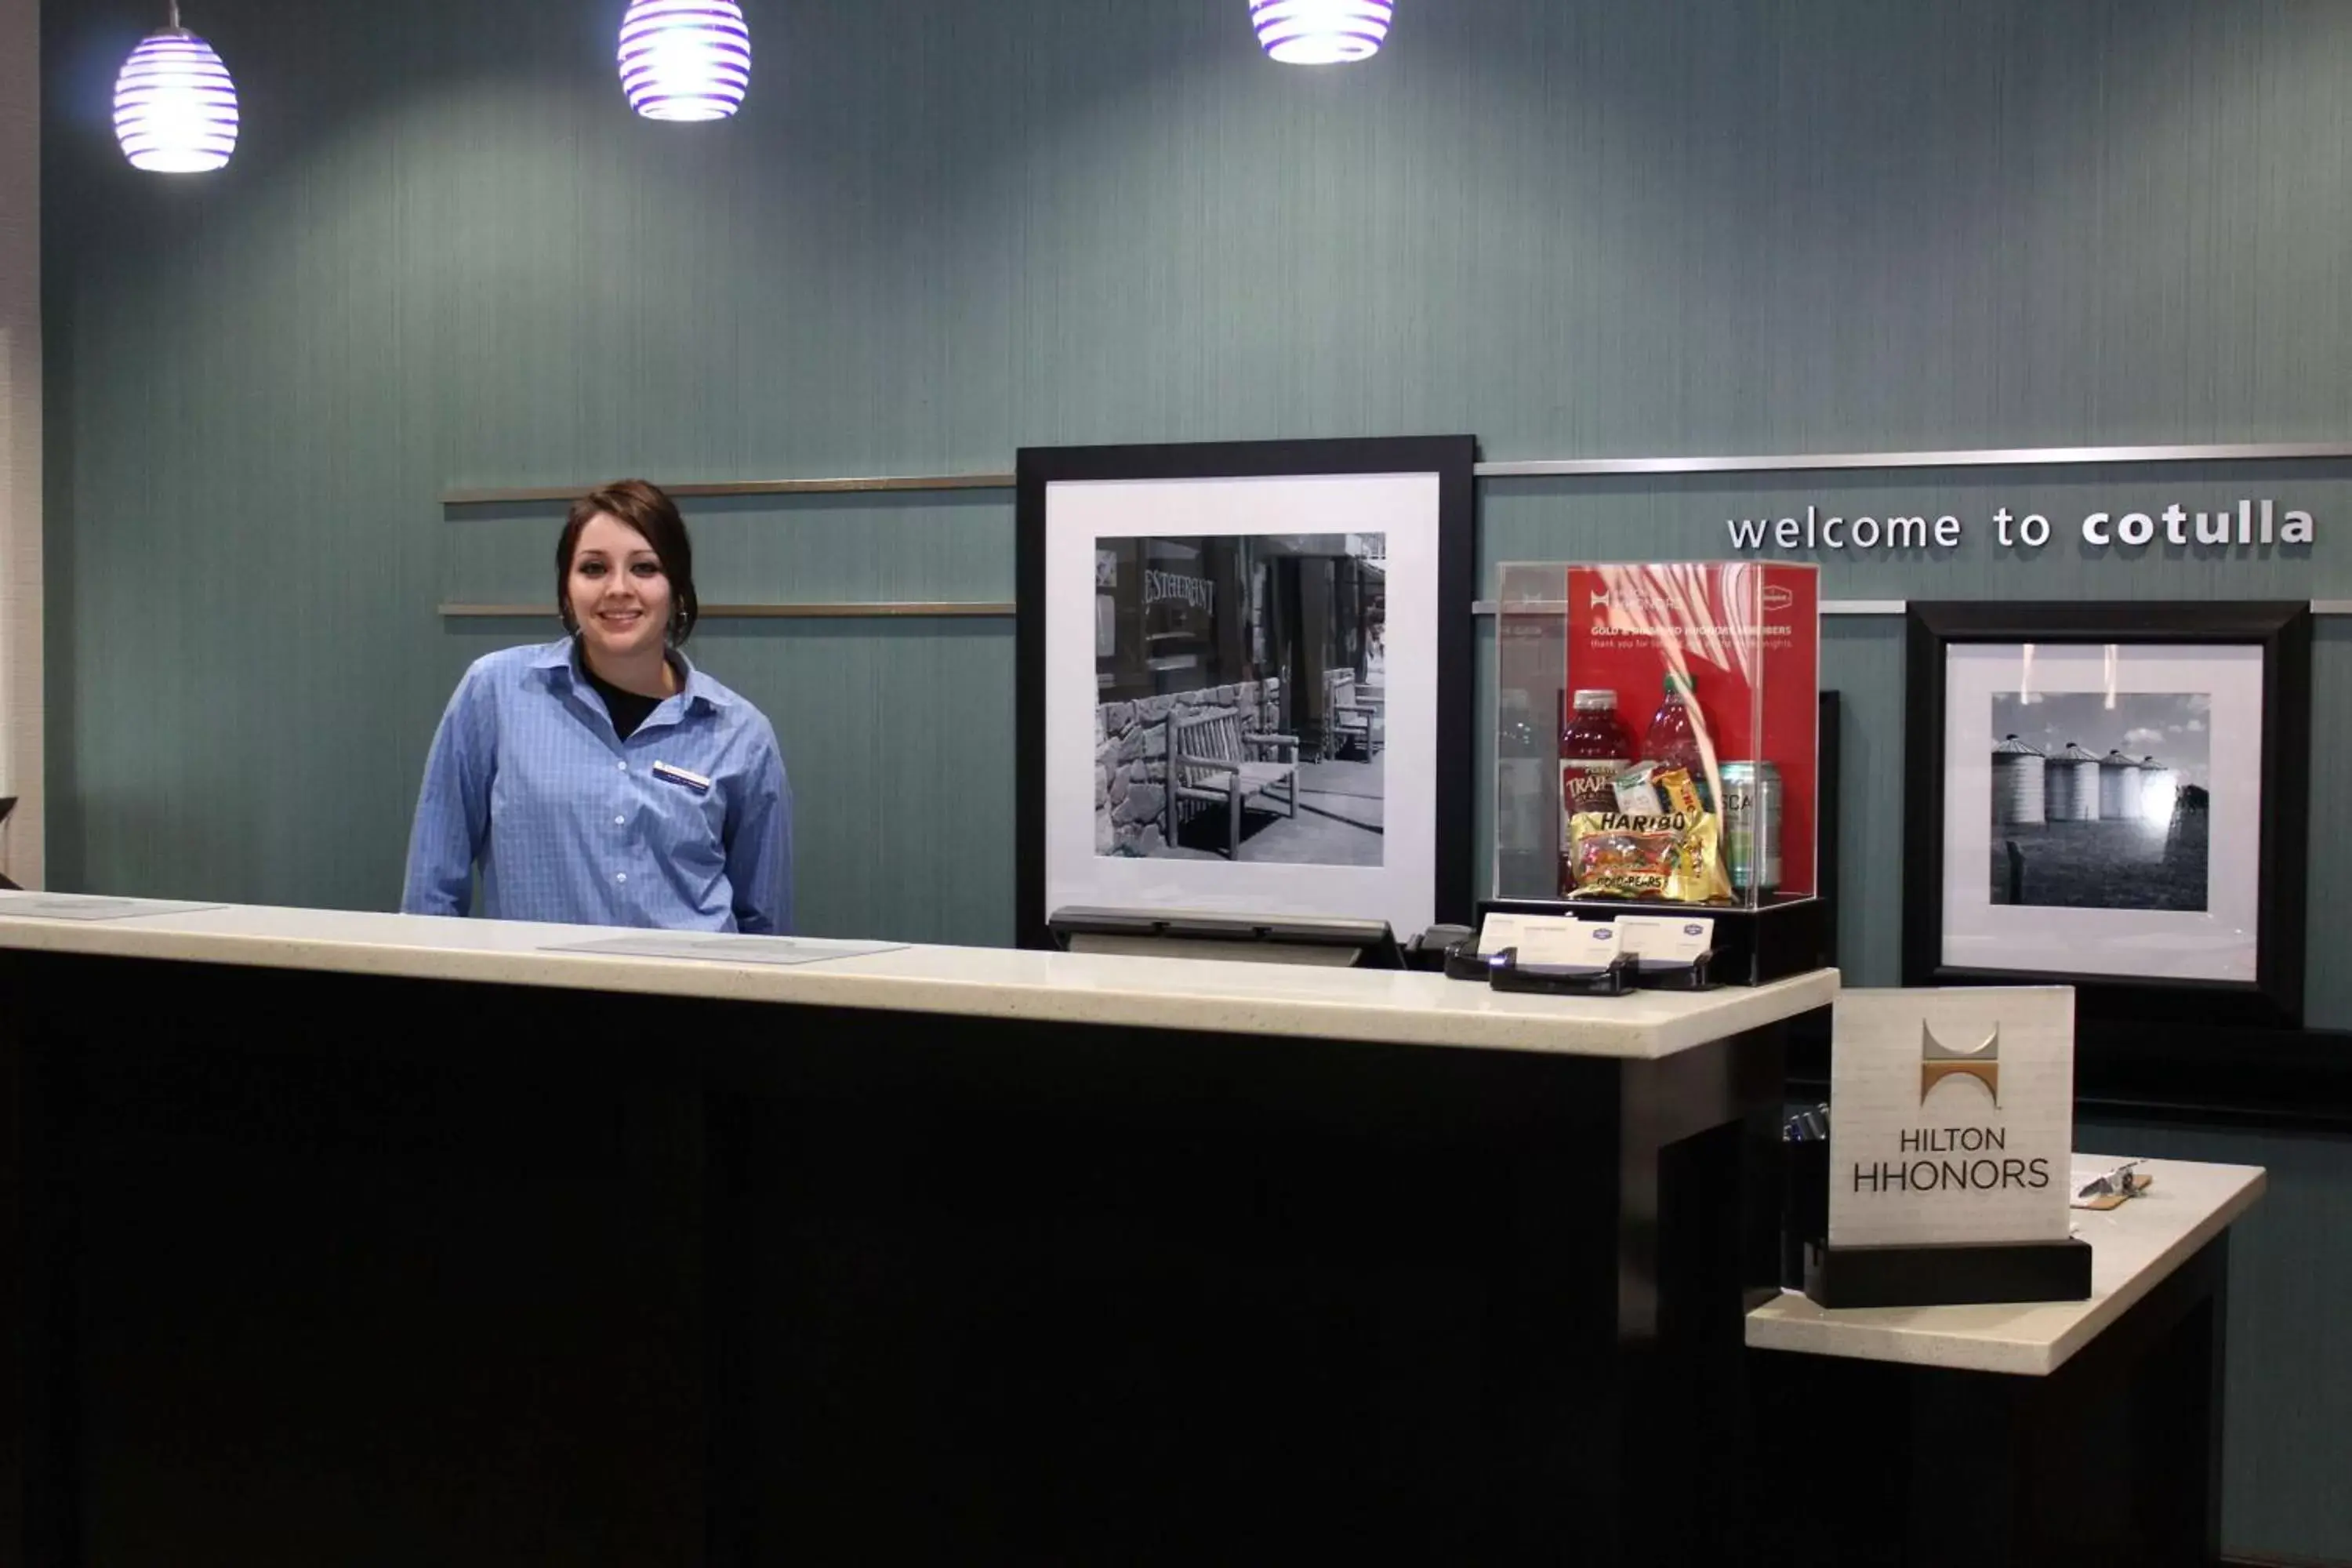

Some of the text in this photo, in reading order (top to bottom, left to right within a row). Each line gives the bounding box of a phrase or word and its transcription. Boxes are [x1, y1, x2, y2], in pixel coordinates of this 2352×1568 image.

[1727, 499, 2314, 550] welcome to cotulla
[1142, 569, 1214, 616] ESTAURANT
[1601, 811, 1685, 830] HARIBO
[1900, 1127, 2006, 1152] HILTON
[1853, 1158, 2050, 1192] HHONORS
